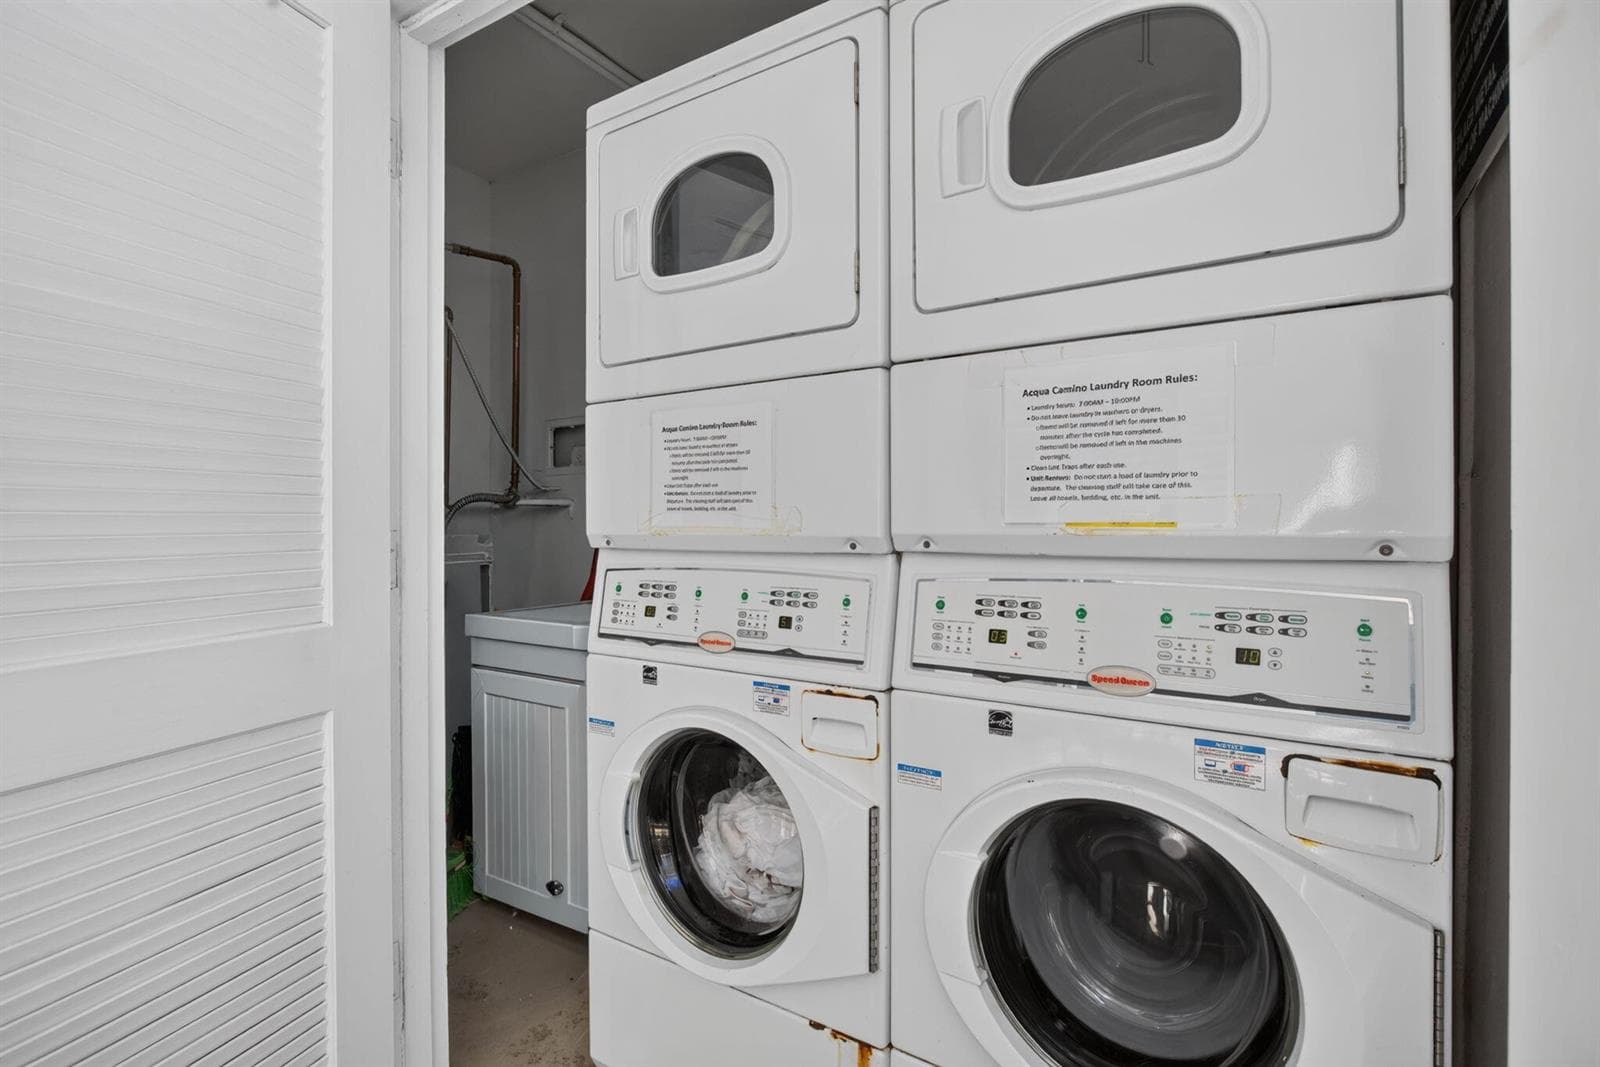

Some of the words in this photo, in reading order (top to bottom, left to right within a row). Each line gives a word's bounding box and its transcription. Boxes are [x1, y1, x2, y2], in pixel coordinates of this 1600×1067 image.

[1022, 388, 1050, 399] Acqua
[1052, 384, 1087, 395] Camino
[1089, 380, 1130, 391] Laundry
[1132, 378, 1163, 387] Room
[1165, 373, 1198, 384] Rules:
[1091, 674, 1120, 685] Speed
[1120, 677, 1150, 687] Queen
